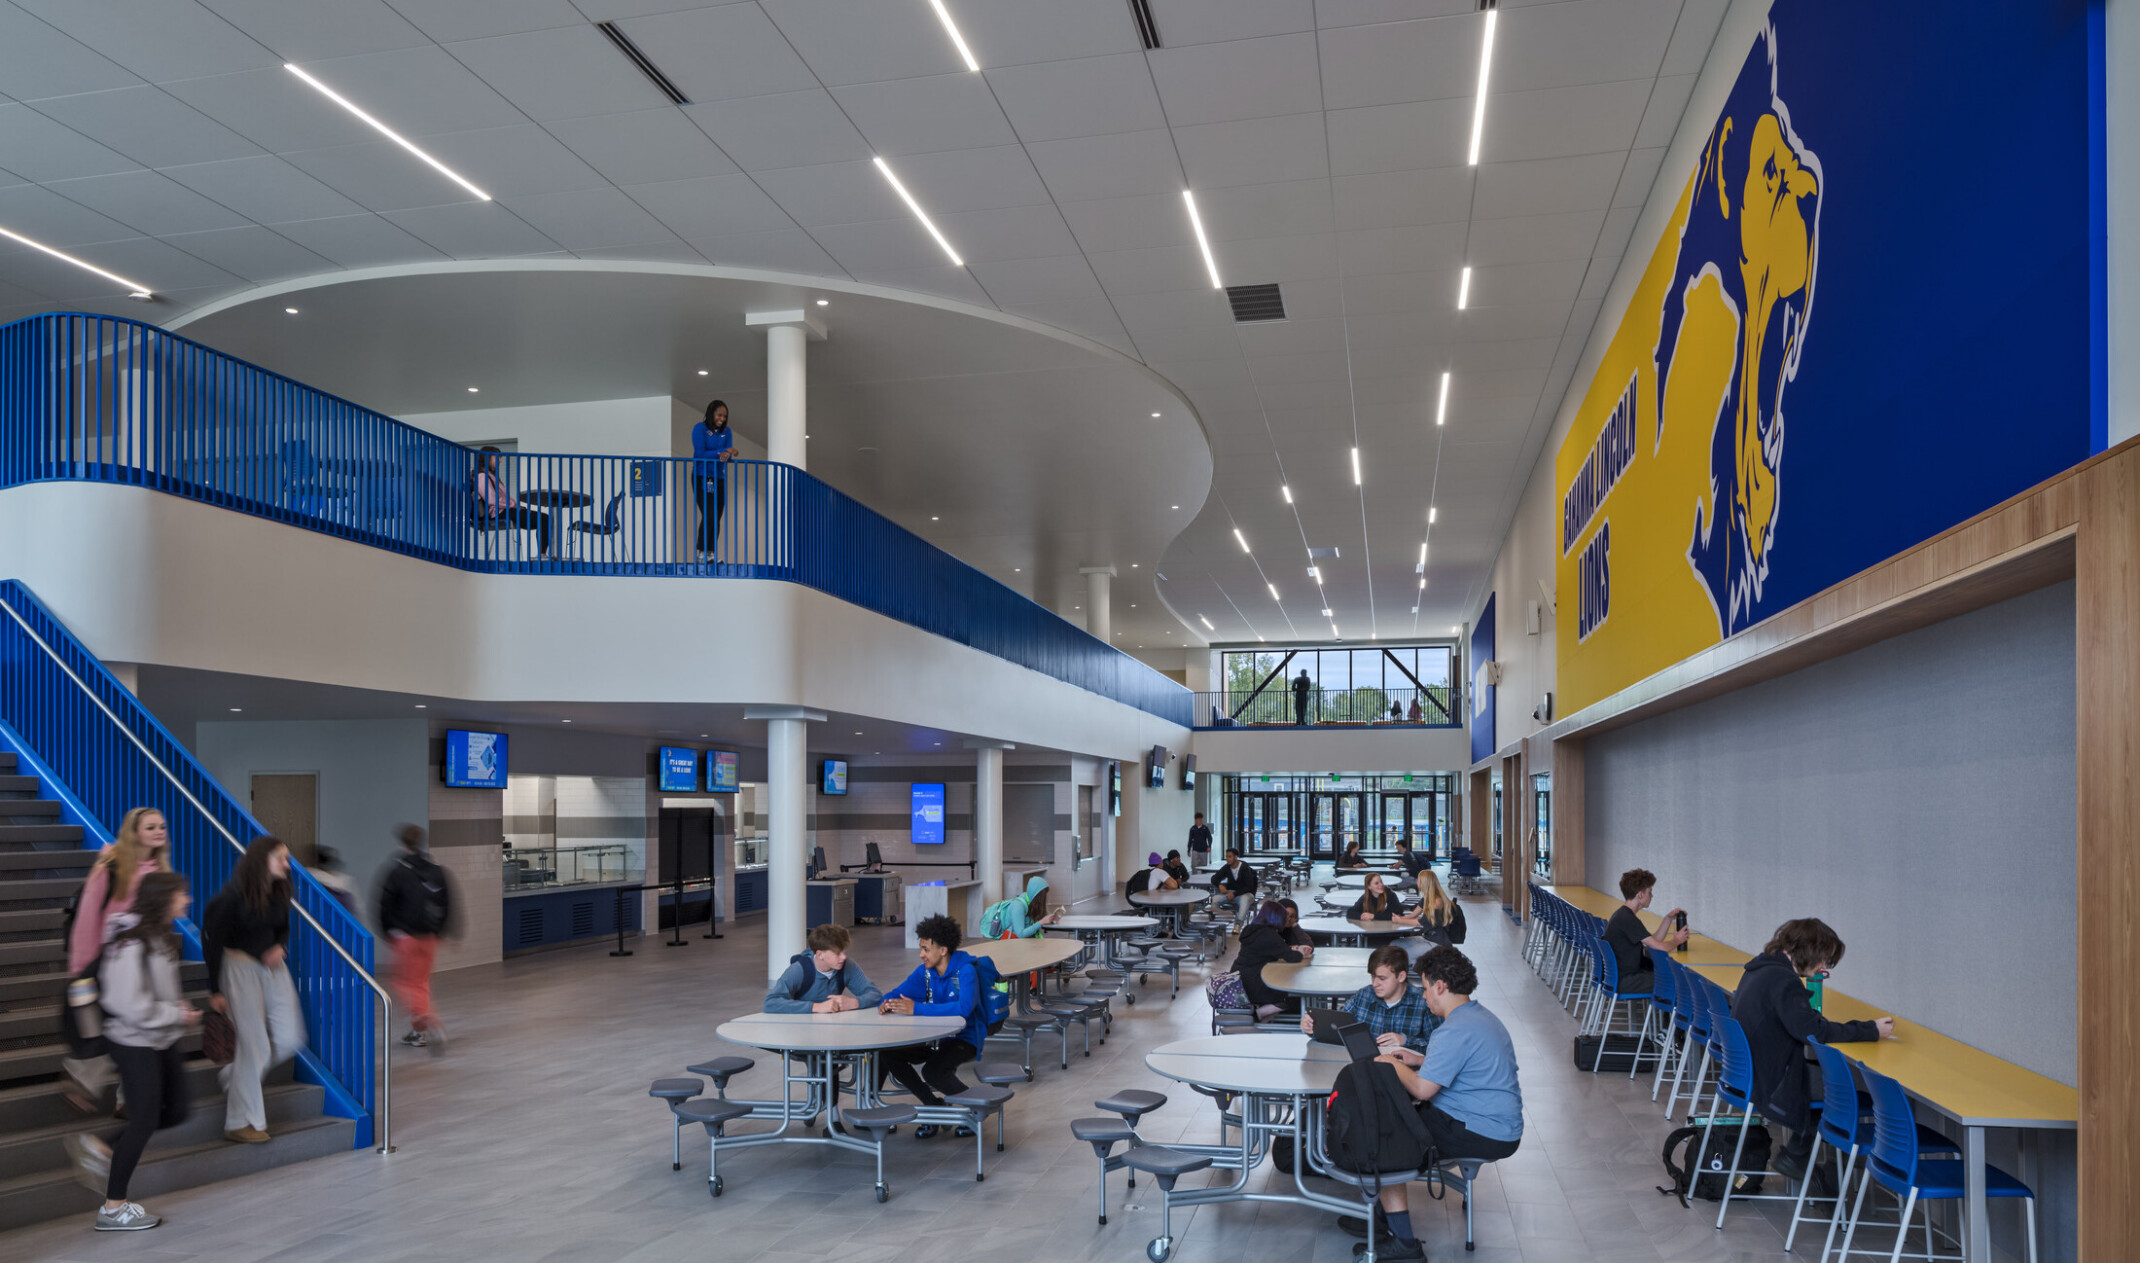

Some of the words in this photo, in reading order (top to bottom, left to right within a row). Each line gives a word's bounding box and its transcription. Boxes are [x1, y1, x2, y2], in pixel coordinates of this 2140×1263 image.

[634, 467, 642, 480] 2
[1595, 370, 1638, 512] LINCOLN
[1578, 519, 1610, 643] LIONS
[117, 1212, 135, 1225] N
